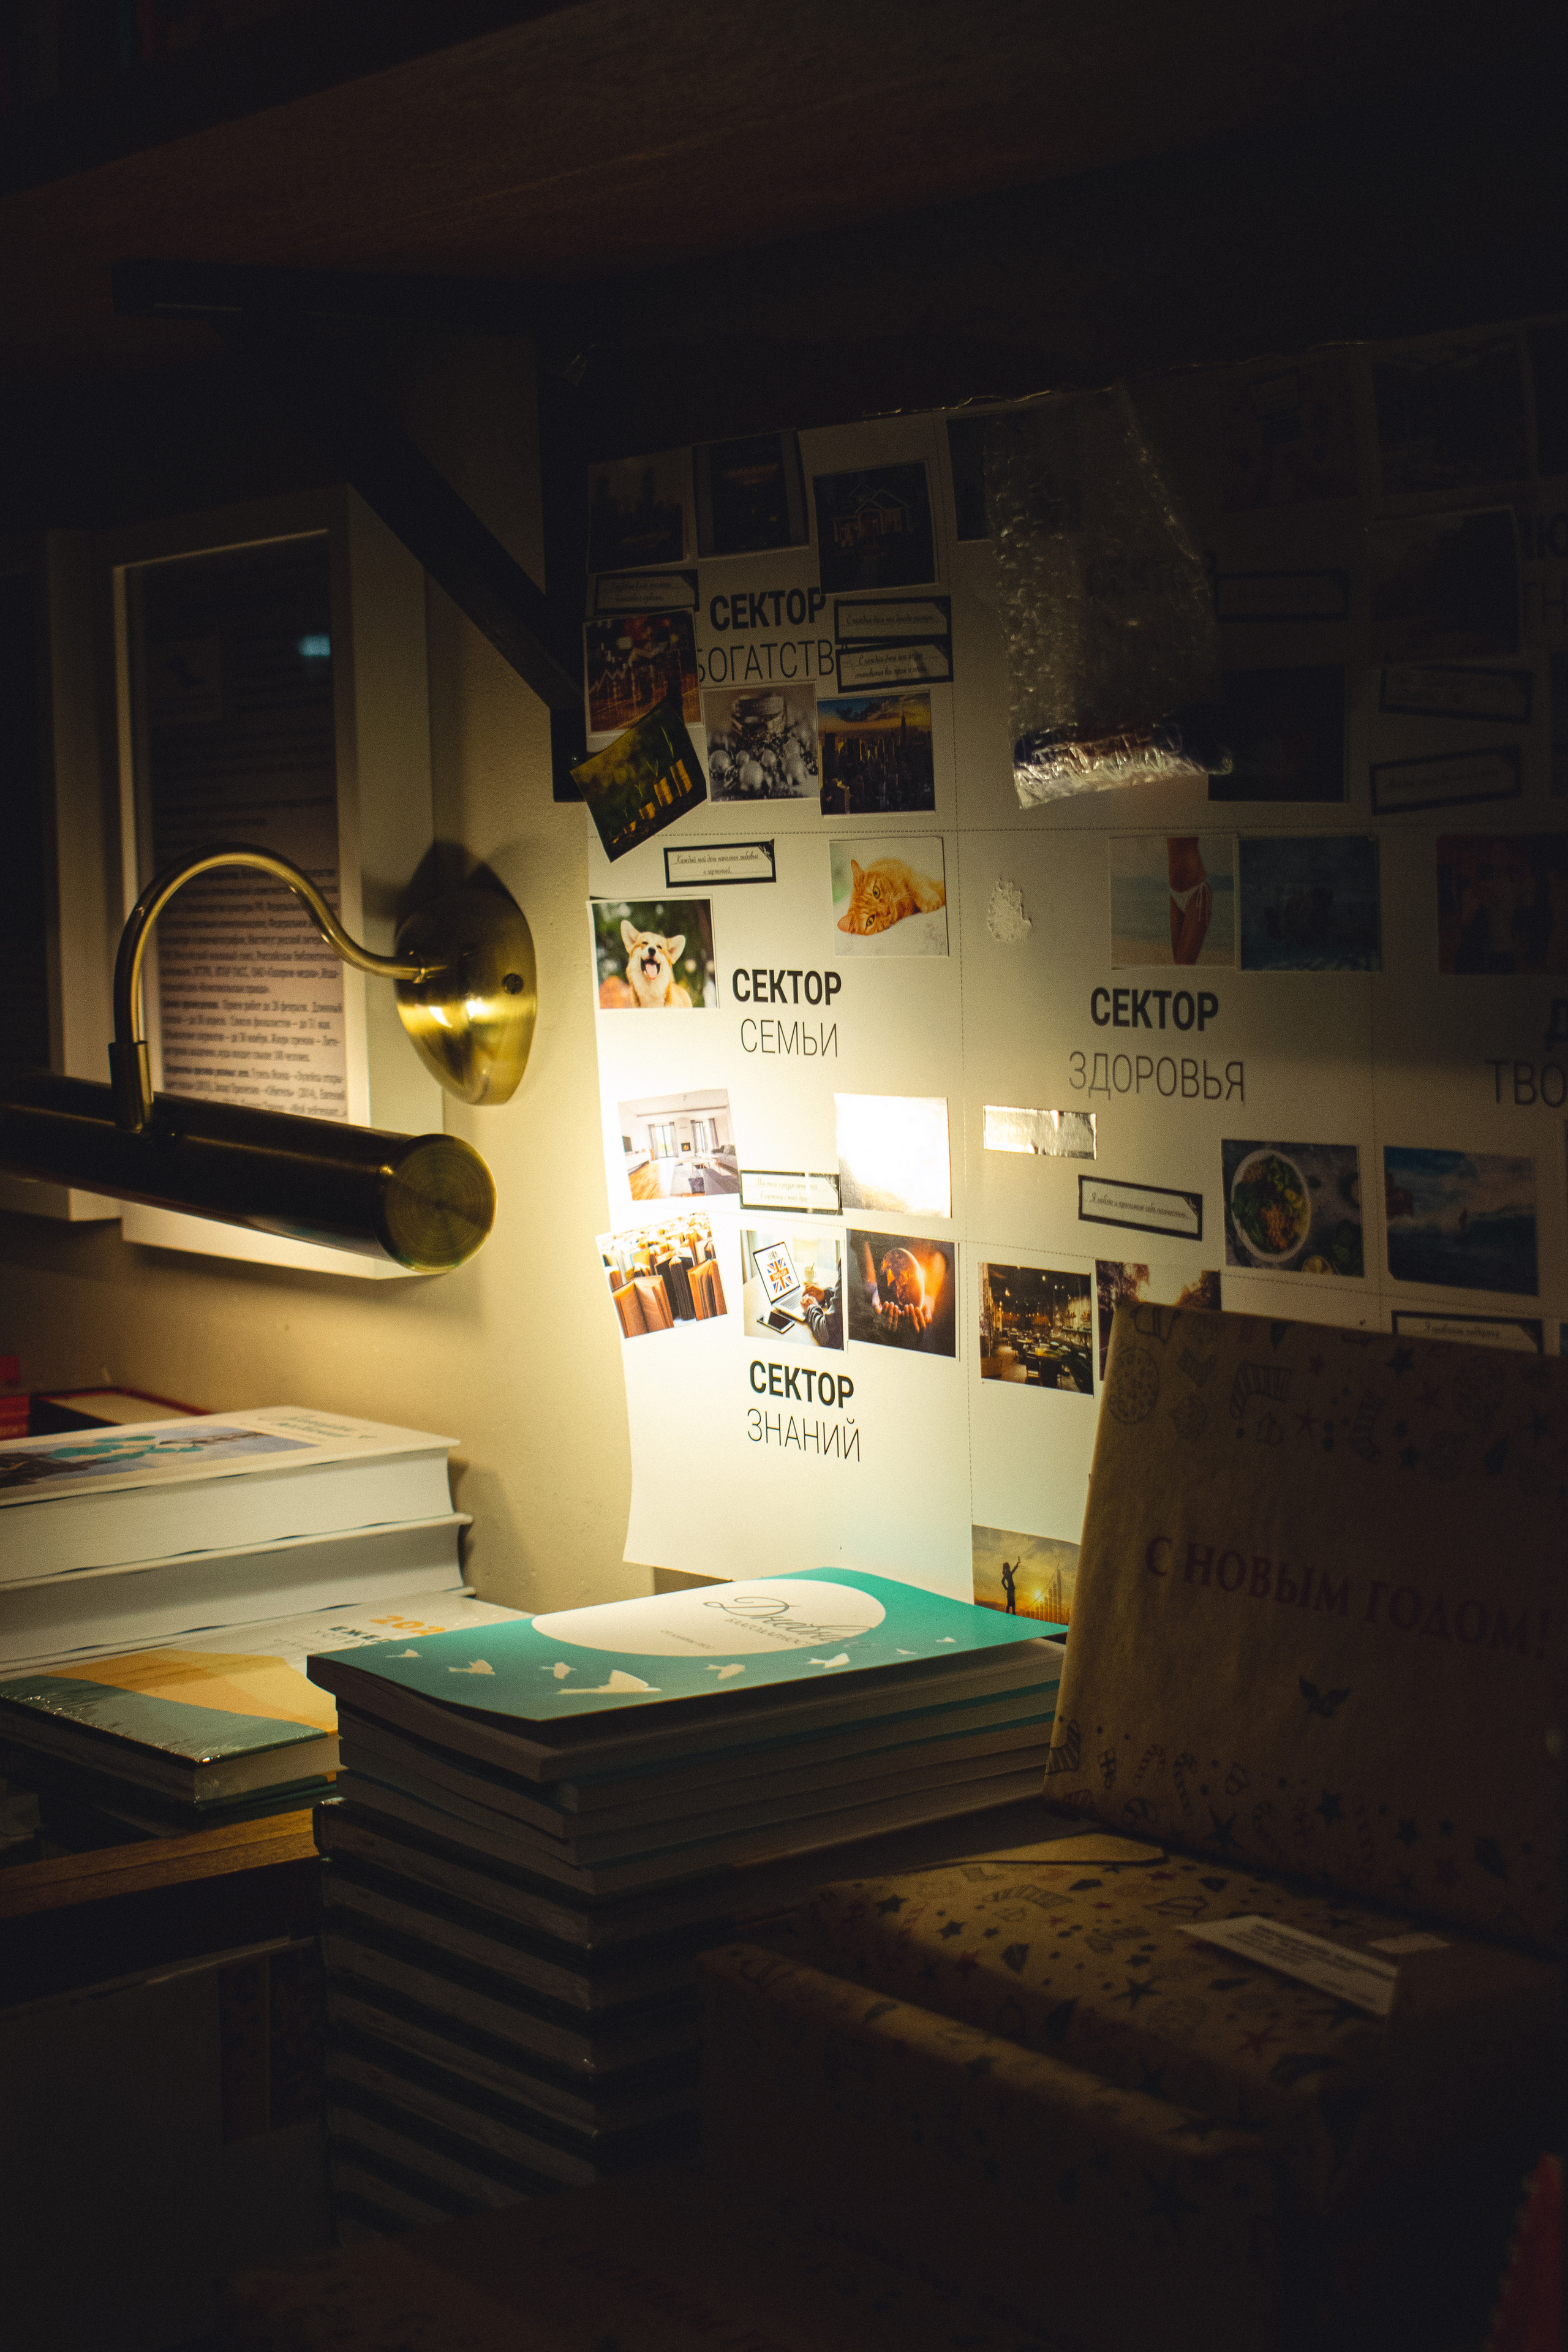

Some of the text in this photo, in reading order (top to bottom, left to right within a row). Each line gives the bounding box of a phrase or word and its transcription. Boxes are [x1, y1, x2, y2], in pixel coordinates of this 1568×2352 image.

[709, 587, 827, 631] СЕКТОР
[698, 639, 847, 683] ОГАТСТВ
[732, 968, 842, 1006] СЕКТОР
[1090, 987, 1219, 1032] СЕКТОР
[741, 1019, 838, 1058] СЕМЬИ
[1069, 1051, 1245, 1104] ЗДОРОВЬЯ
[749, 1360, 854, 1408] СЕКТОР
[747, 1408, 861, 1462] ЗНАНИЙ
[1183, 1541, 1348, 1618] НОВЫМ
[1364, 1578, 1552, 1659] ГОДОМ!
